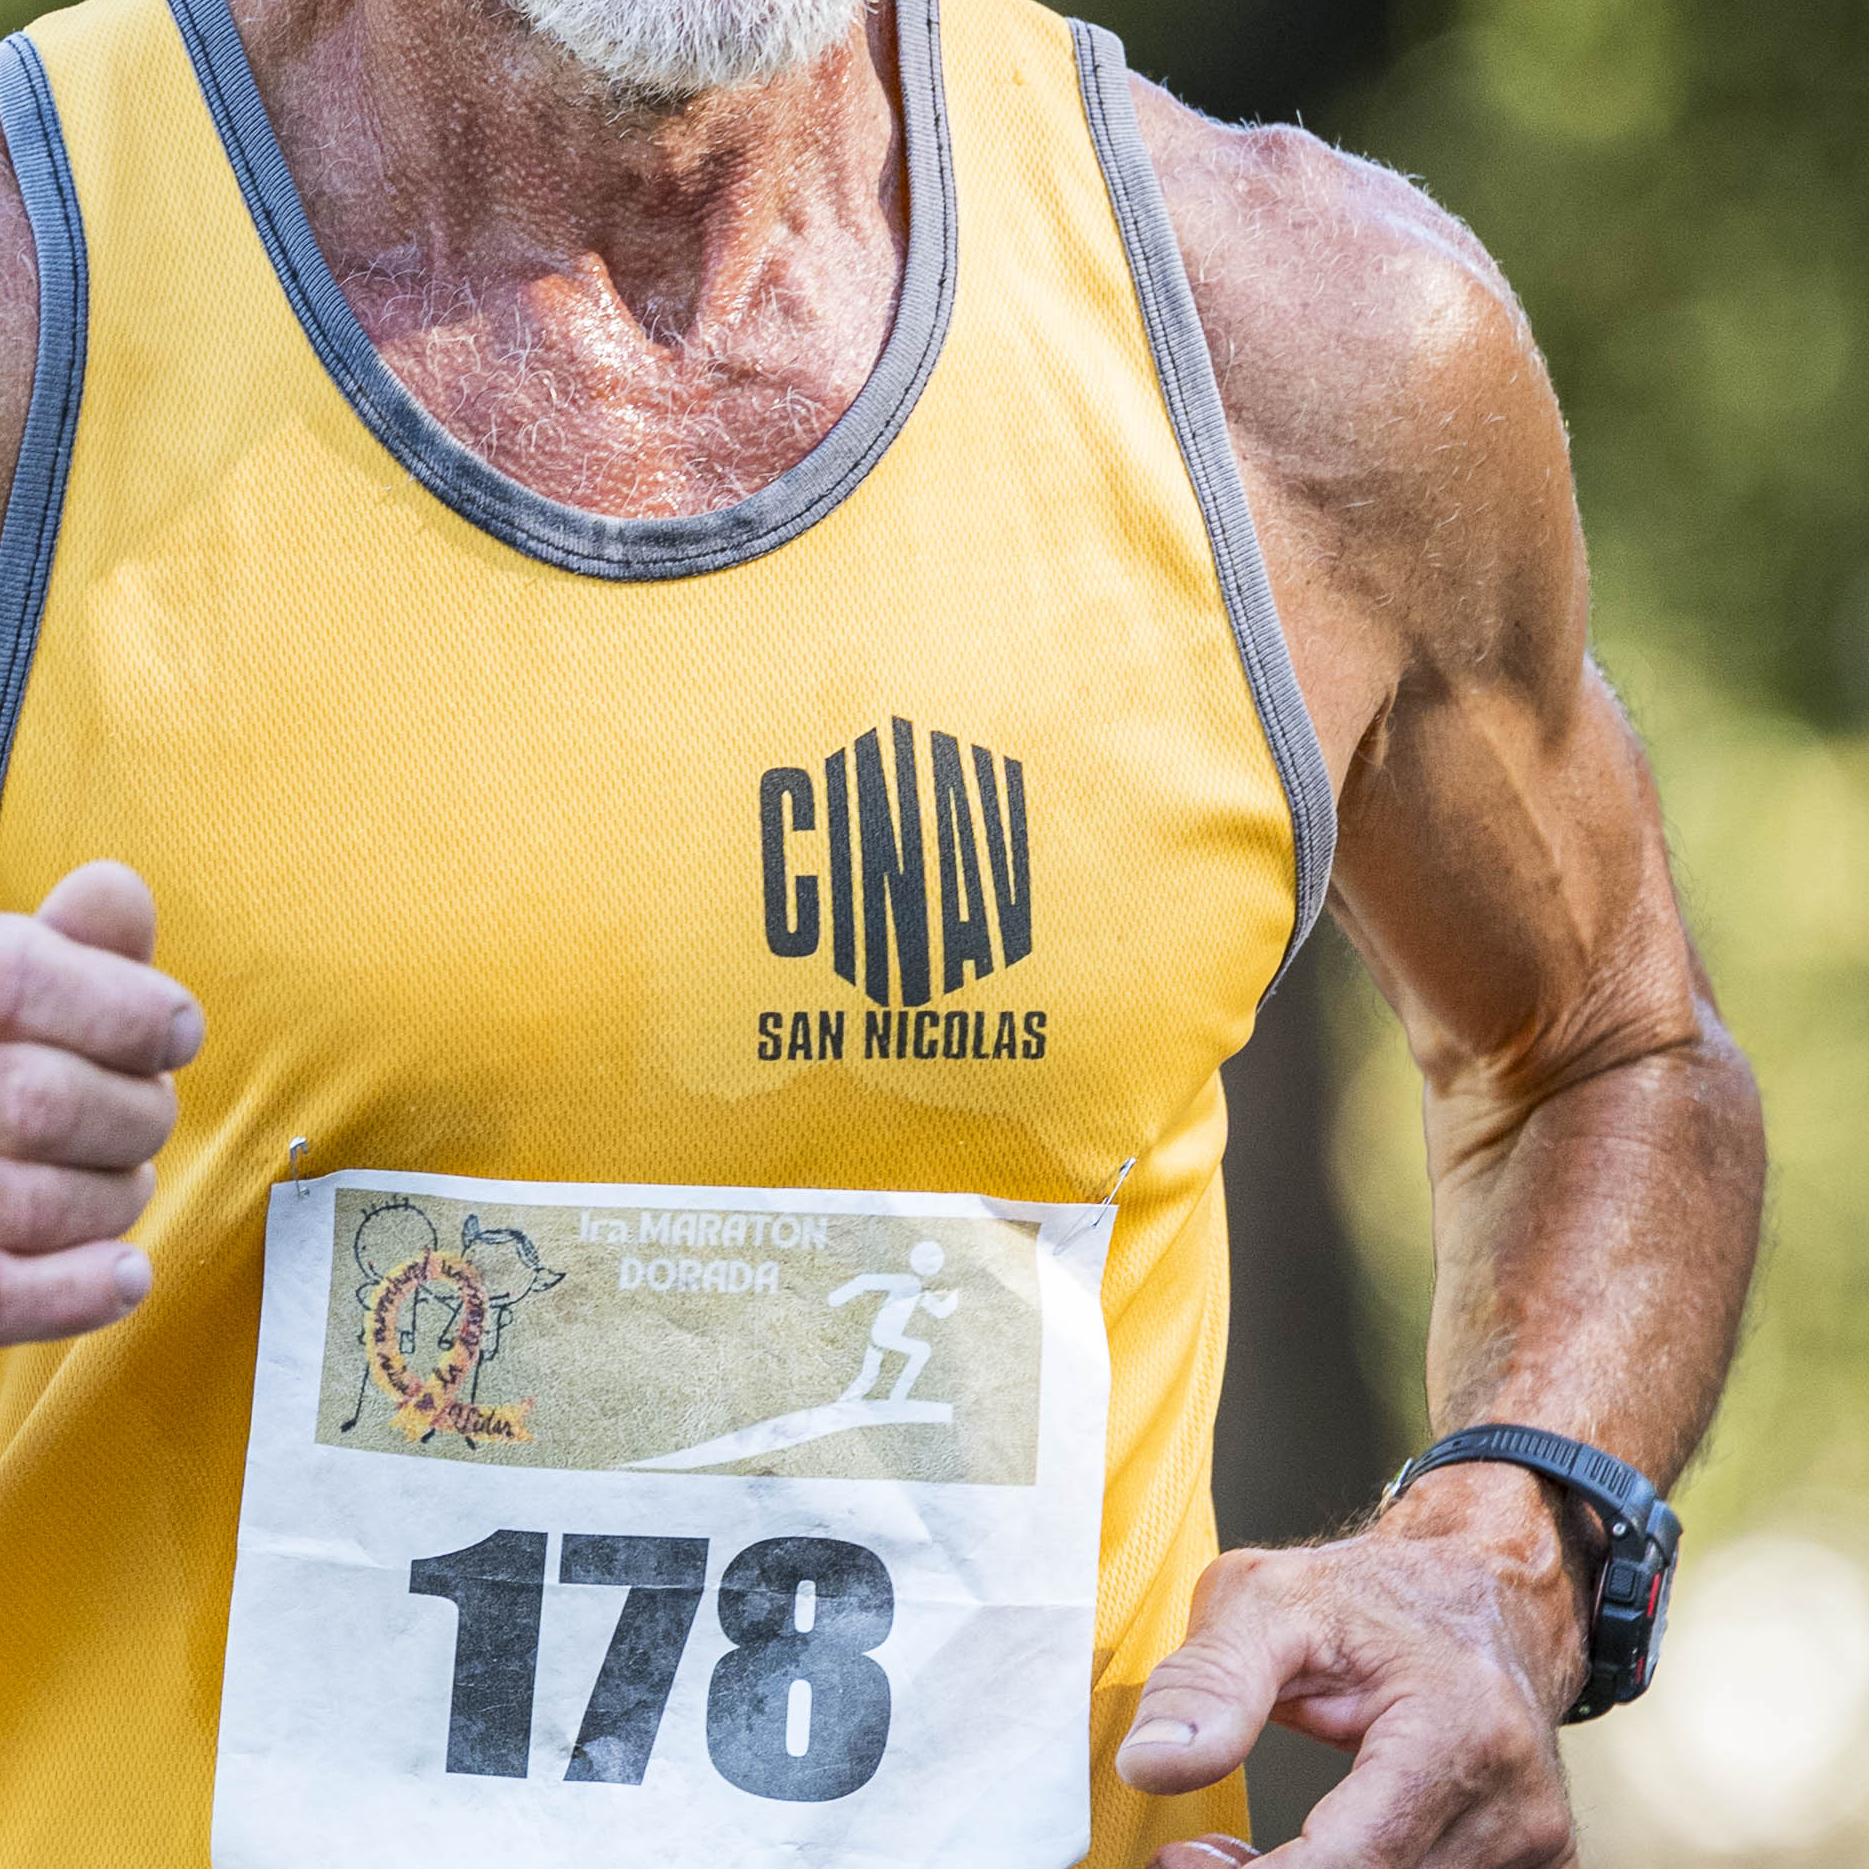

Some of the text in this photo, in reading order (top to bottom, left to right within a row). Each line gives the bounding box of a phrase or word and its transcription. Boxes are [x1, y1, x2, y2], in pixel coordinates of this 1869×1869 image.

[760, 715, 1033, 1008] CINAV
[757, 1010, 1047, 1062] SAN NICOLAS
[617, 1256, 779, 1294] DORADA
[408, 1528, 895, 1803] 178
